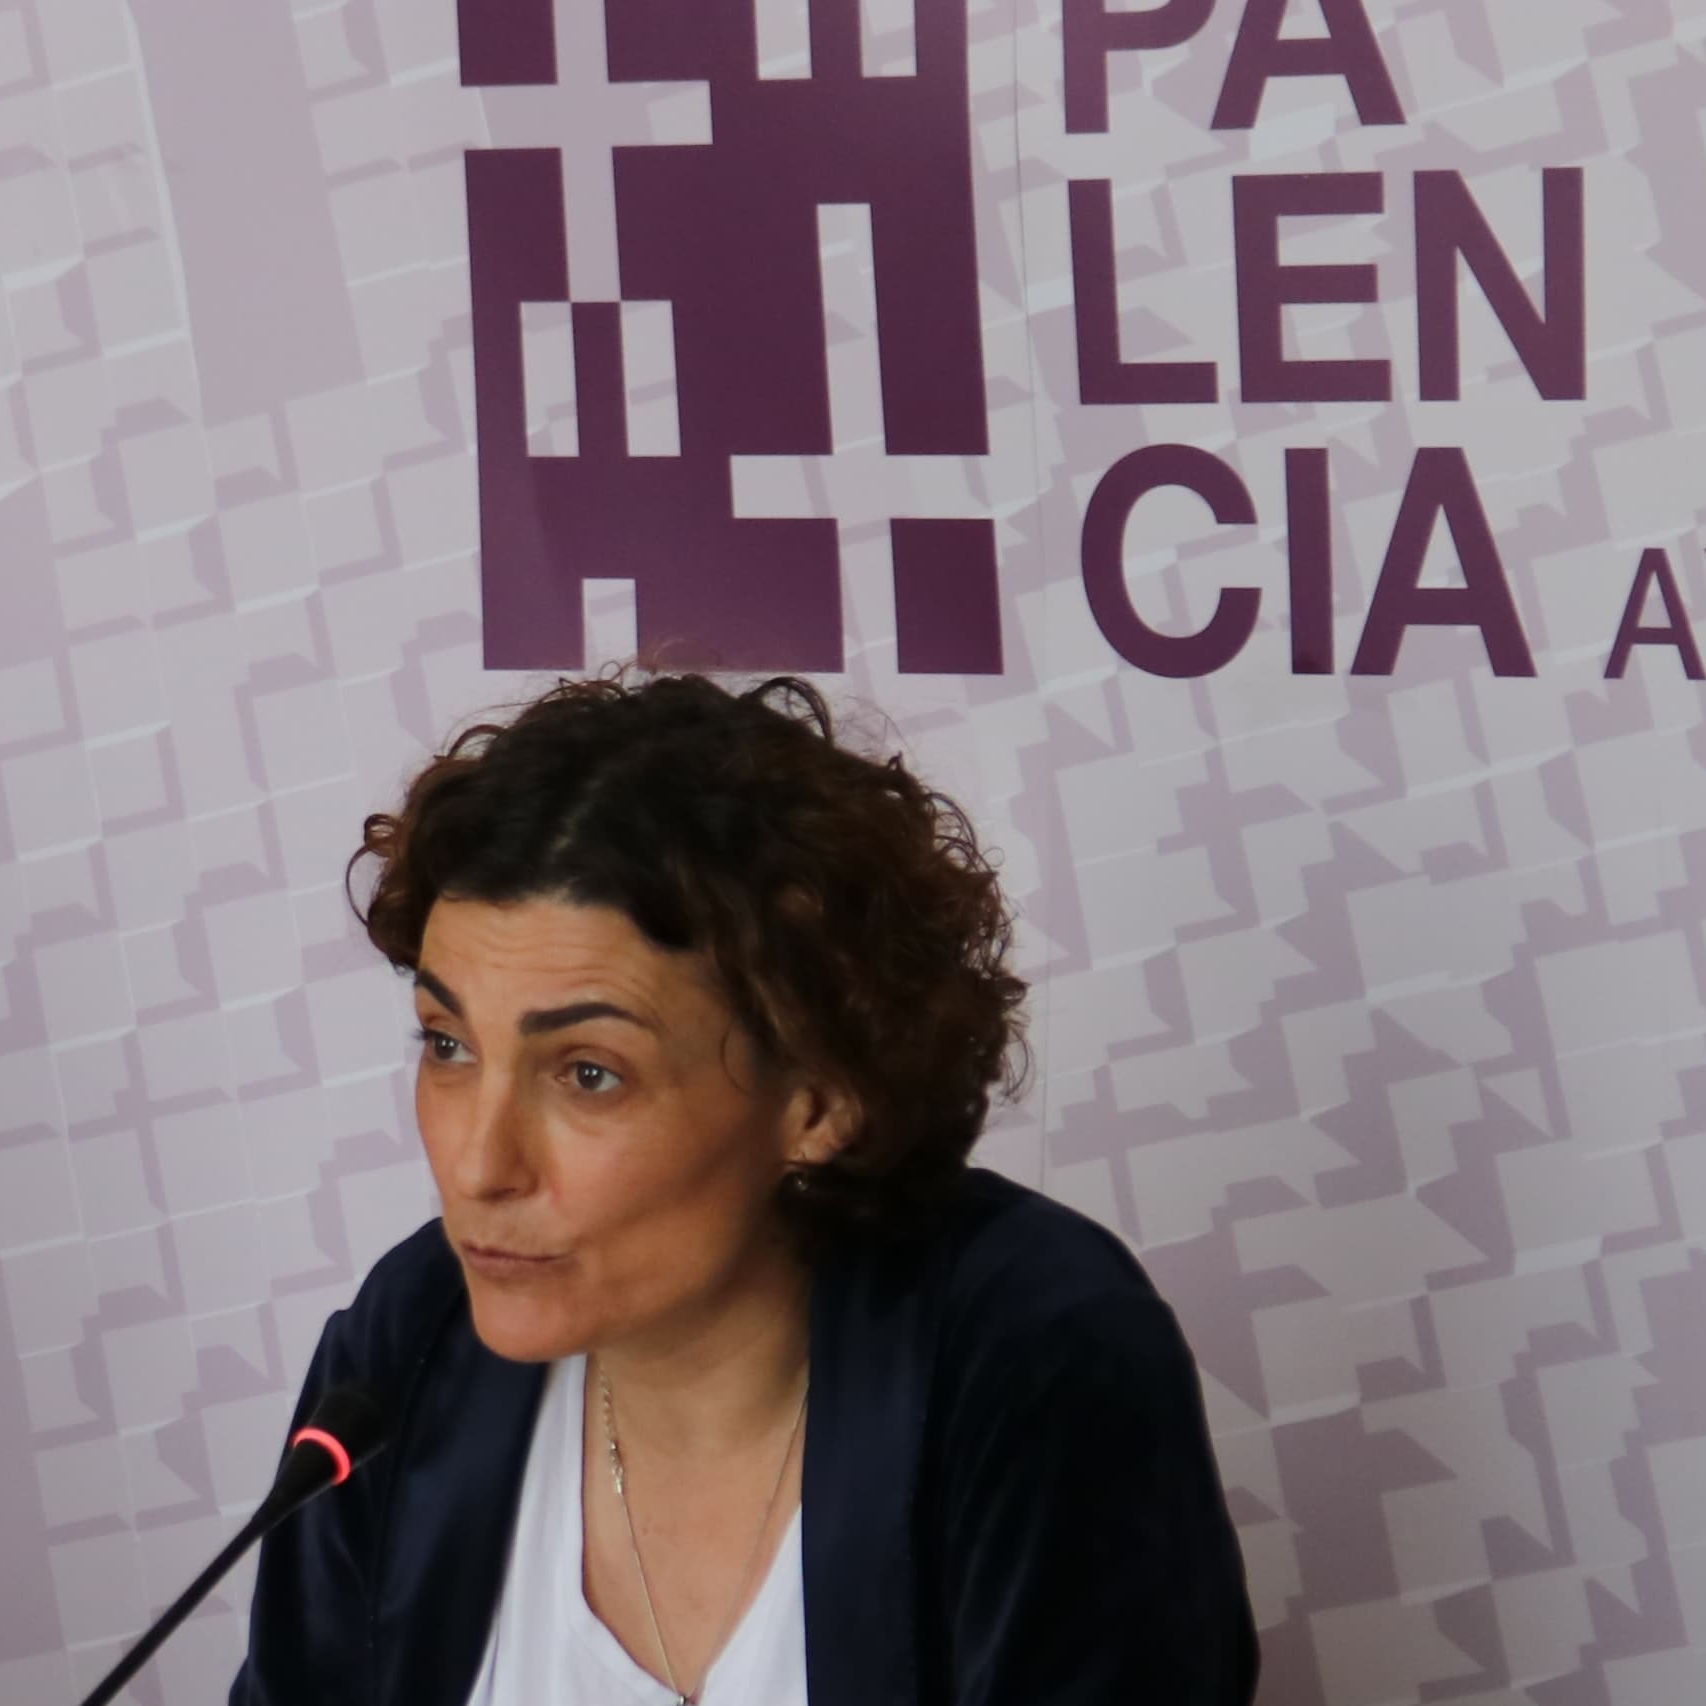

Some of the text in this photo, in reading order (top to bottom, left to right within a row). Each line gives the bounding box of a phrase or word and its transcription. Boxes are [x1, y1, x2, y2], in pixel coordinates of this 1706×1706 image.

[1063, 0, 1406, 134] PA
[1069, 166, 1587, 405] LEN
[1081, 443, 1538, 680] CIA
